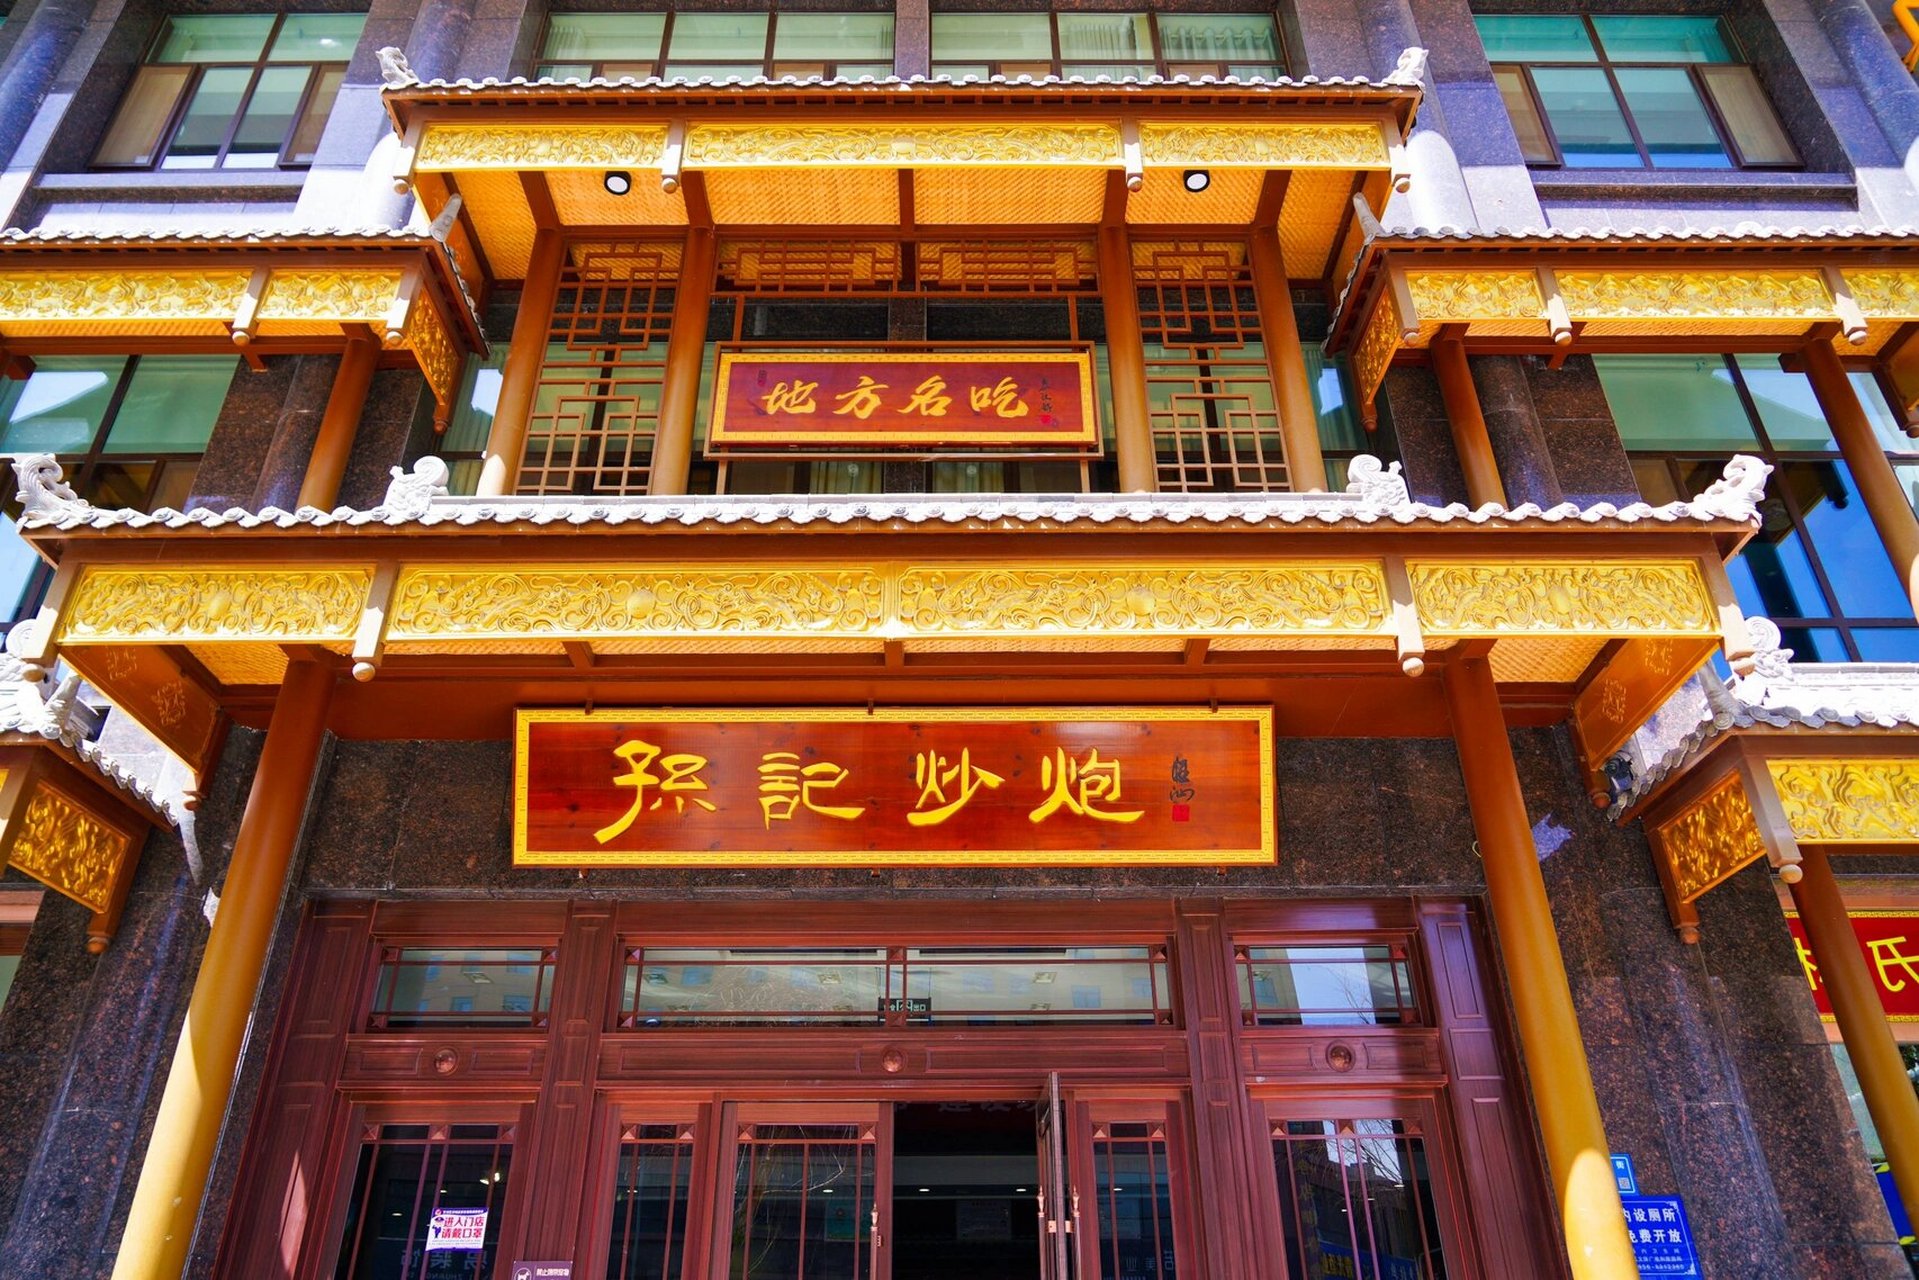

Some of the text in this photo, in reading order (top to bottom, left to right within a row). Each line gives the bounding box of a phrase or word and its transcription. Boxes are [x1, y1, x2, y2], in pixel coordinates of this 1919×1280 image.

[762, 375, 1029, 420] 地方名吃
[442, 1228, 483, 1239] 请戴口罩
